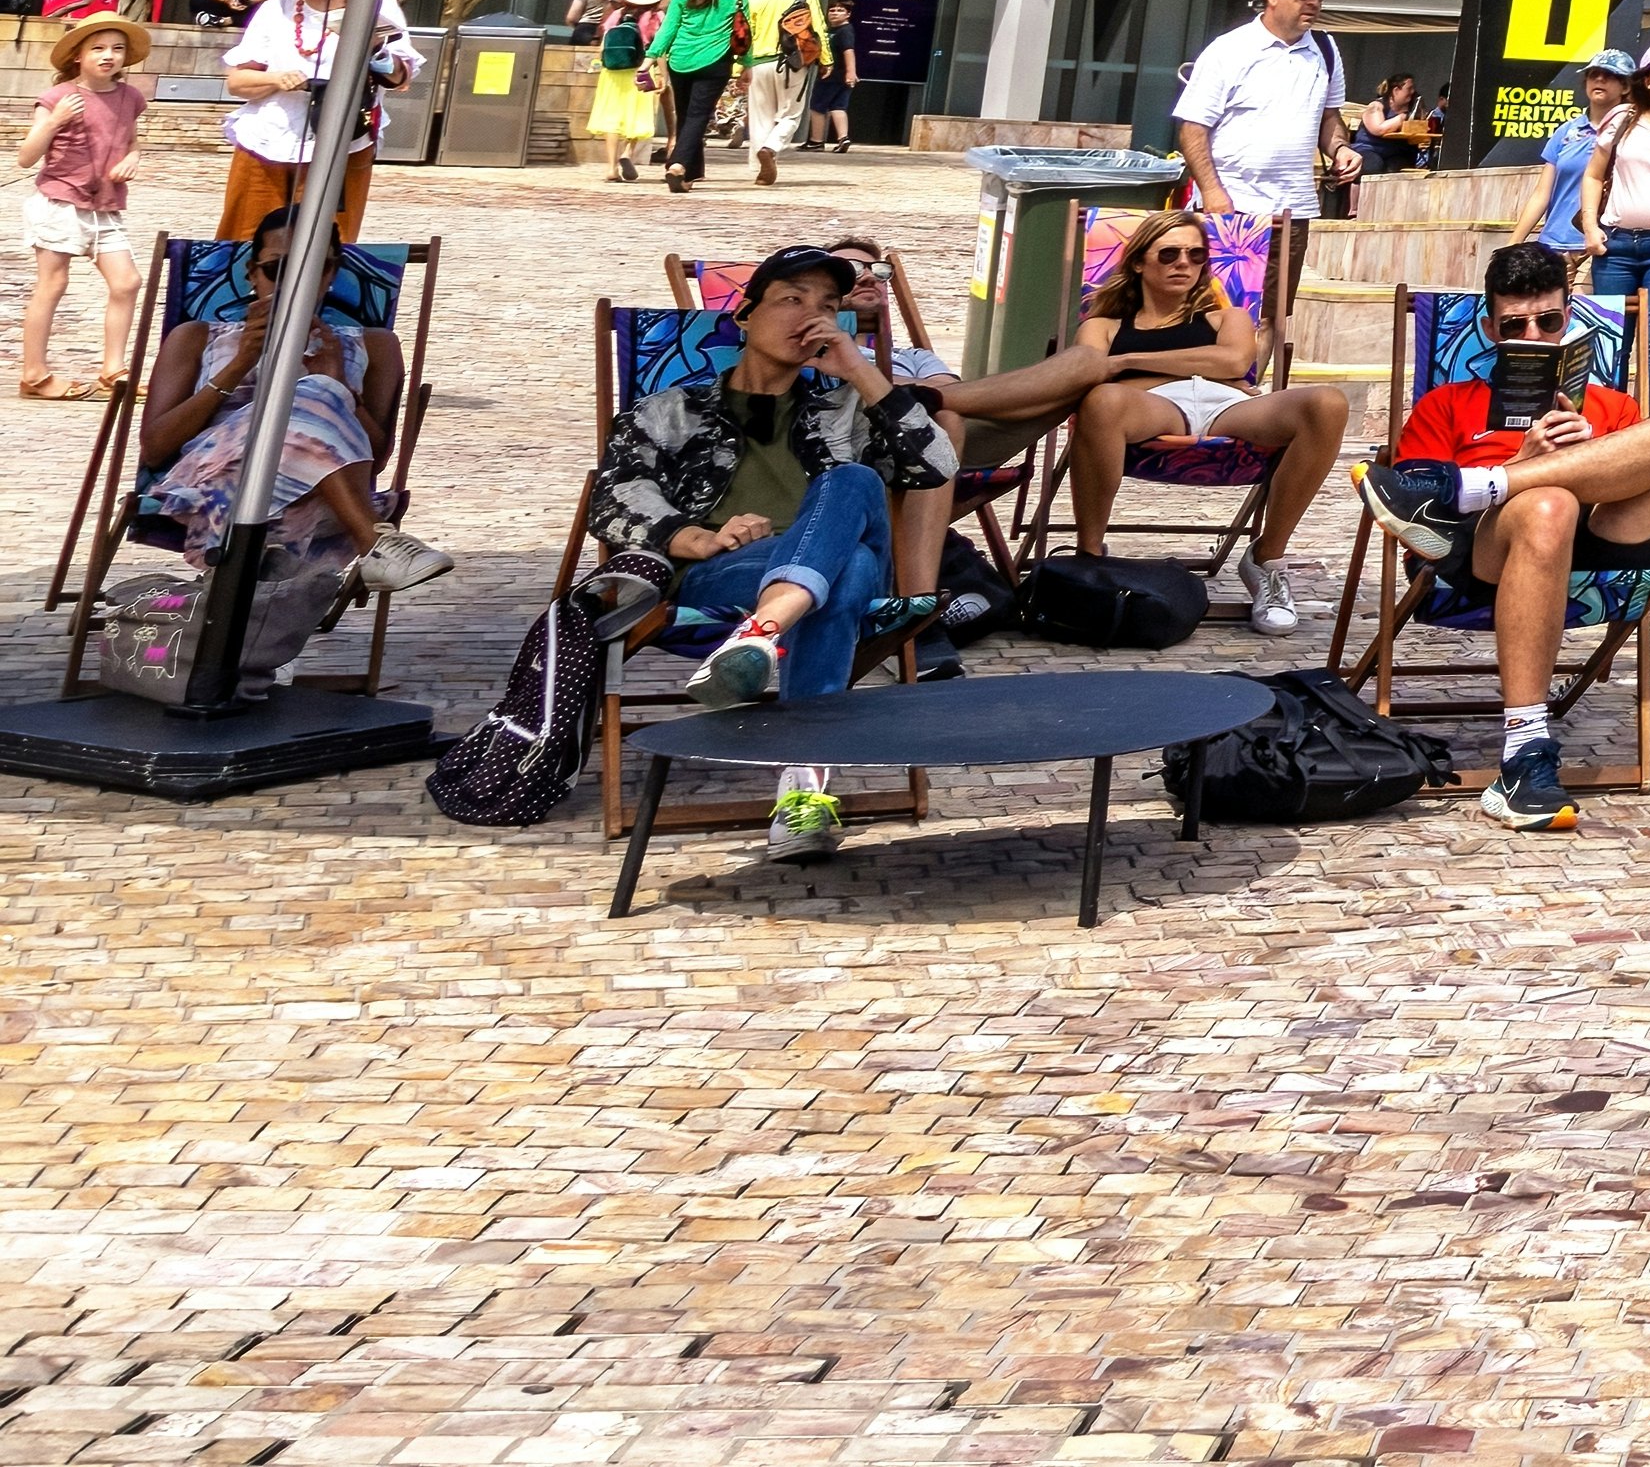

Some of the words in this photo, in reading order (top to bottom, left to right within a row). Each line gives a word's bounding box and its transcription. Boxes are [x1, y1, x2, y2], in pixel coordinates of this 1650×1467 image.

[1496, 86, 1575, 106] KOORIE
[1493, 103, 1587, 122] HERITAG
[1491, 120, 1560, 138] TRUST
